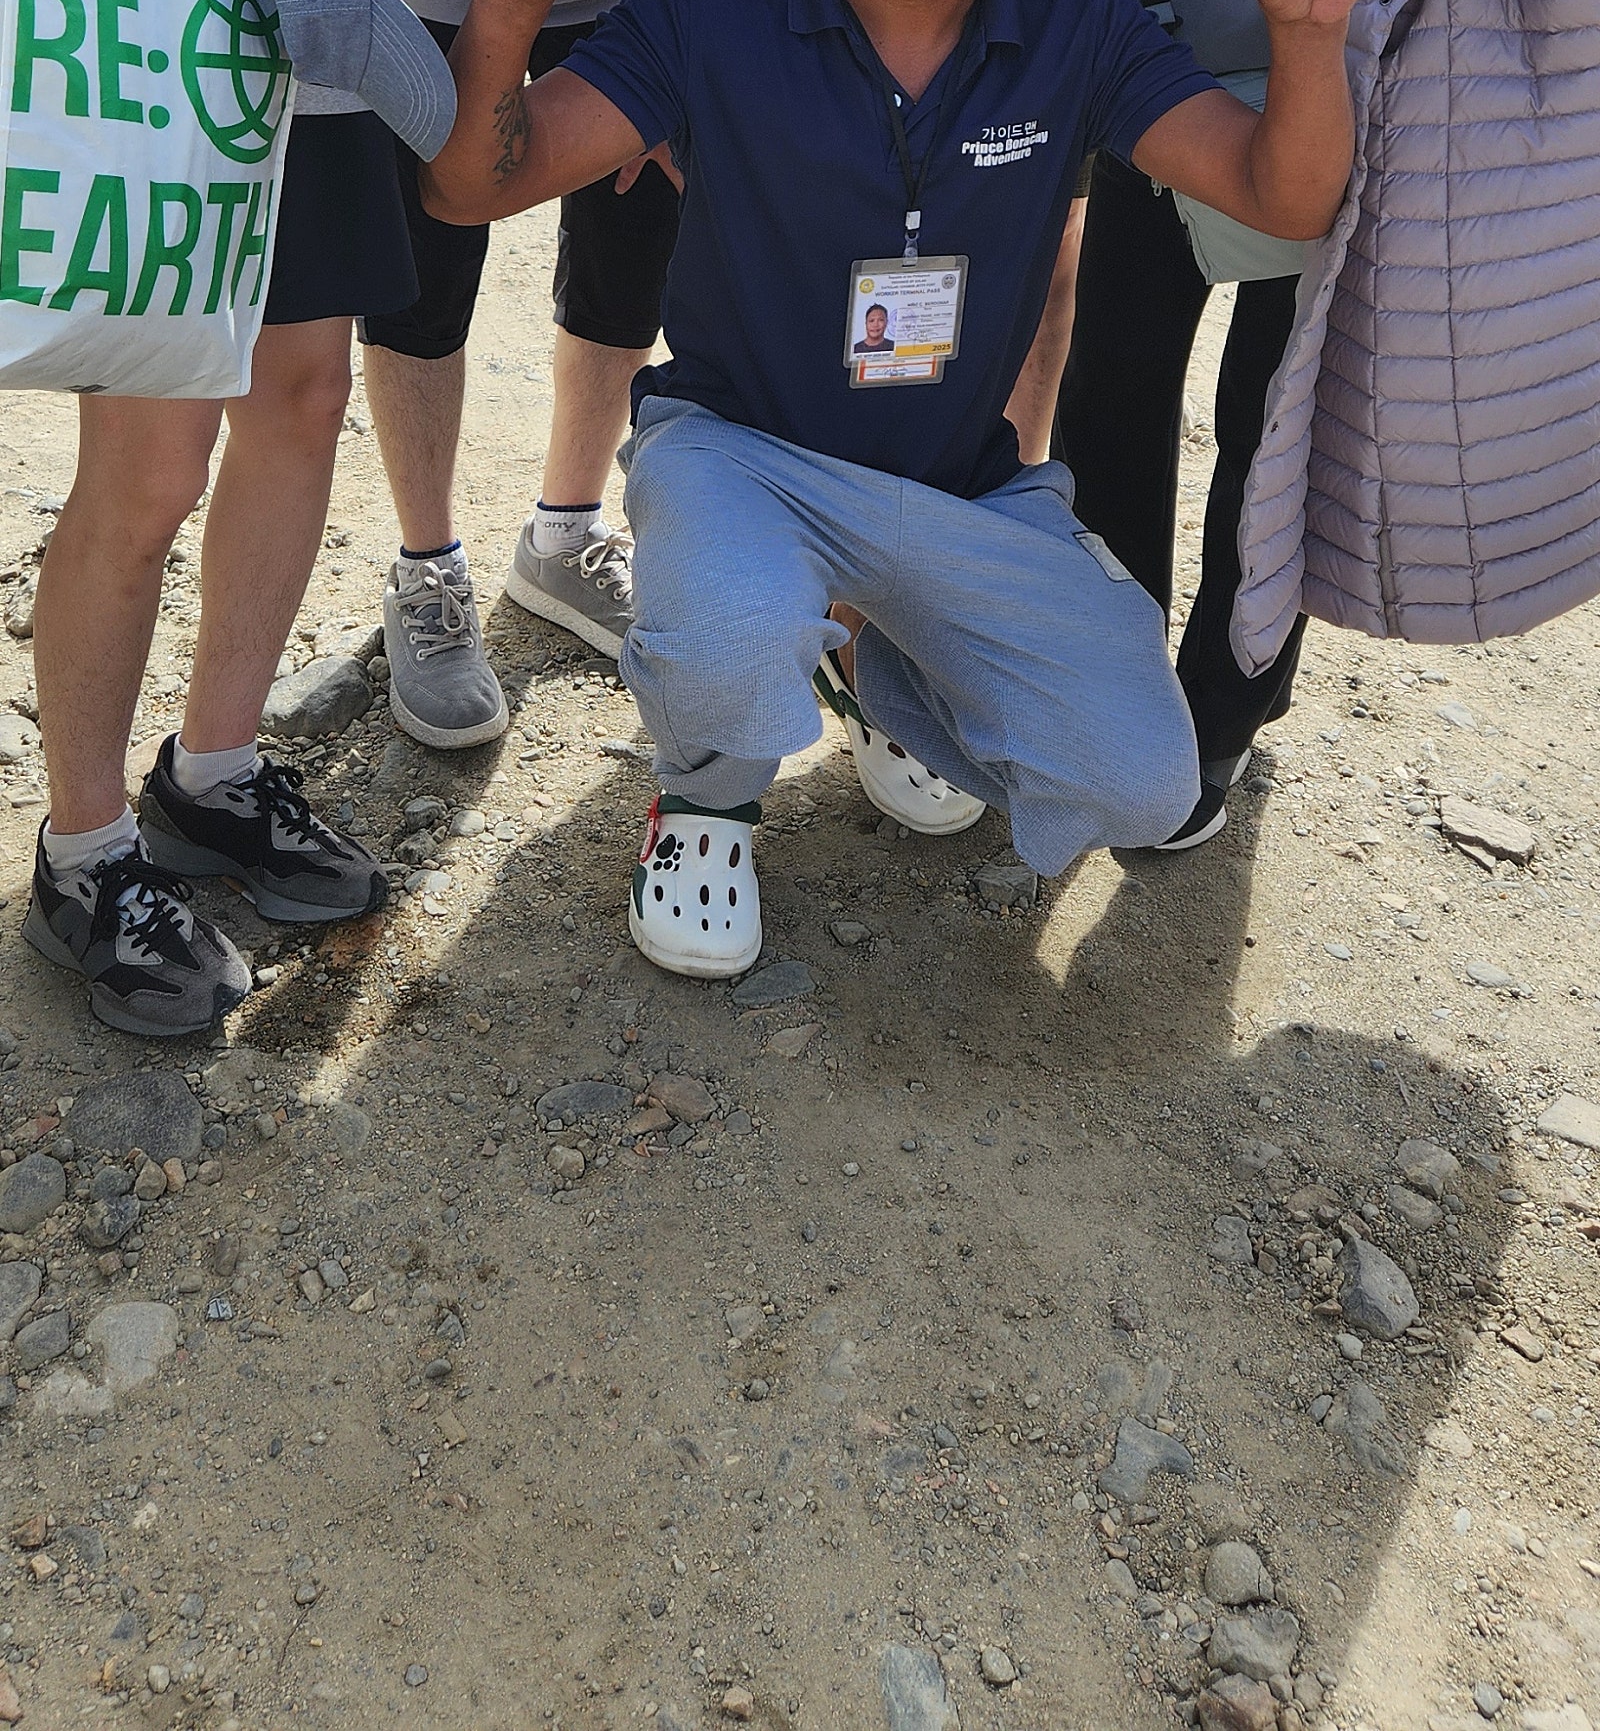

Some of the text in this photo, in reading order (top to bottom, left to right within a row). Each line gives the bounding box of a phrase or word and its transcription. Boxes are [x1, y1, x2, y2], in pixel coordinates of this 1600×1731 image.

[981, 120, 1038, 141] 가이드맨
[961, 130, 1048, 154] Prince Boracay
[974, 147, 1031, 167] Adventure
[0, 167, 274, 316] EARTH
[932, 343, 951, 352] 2025
